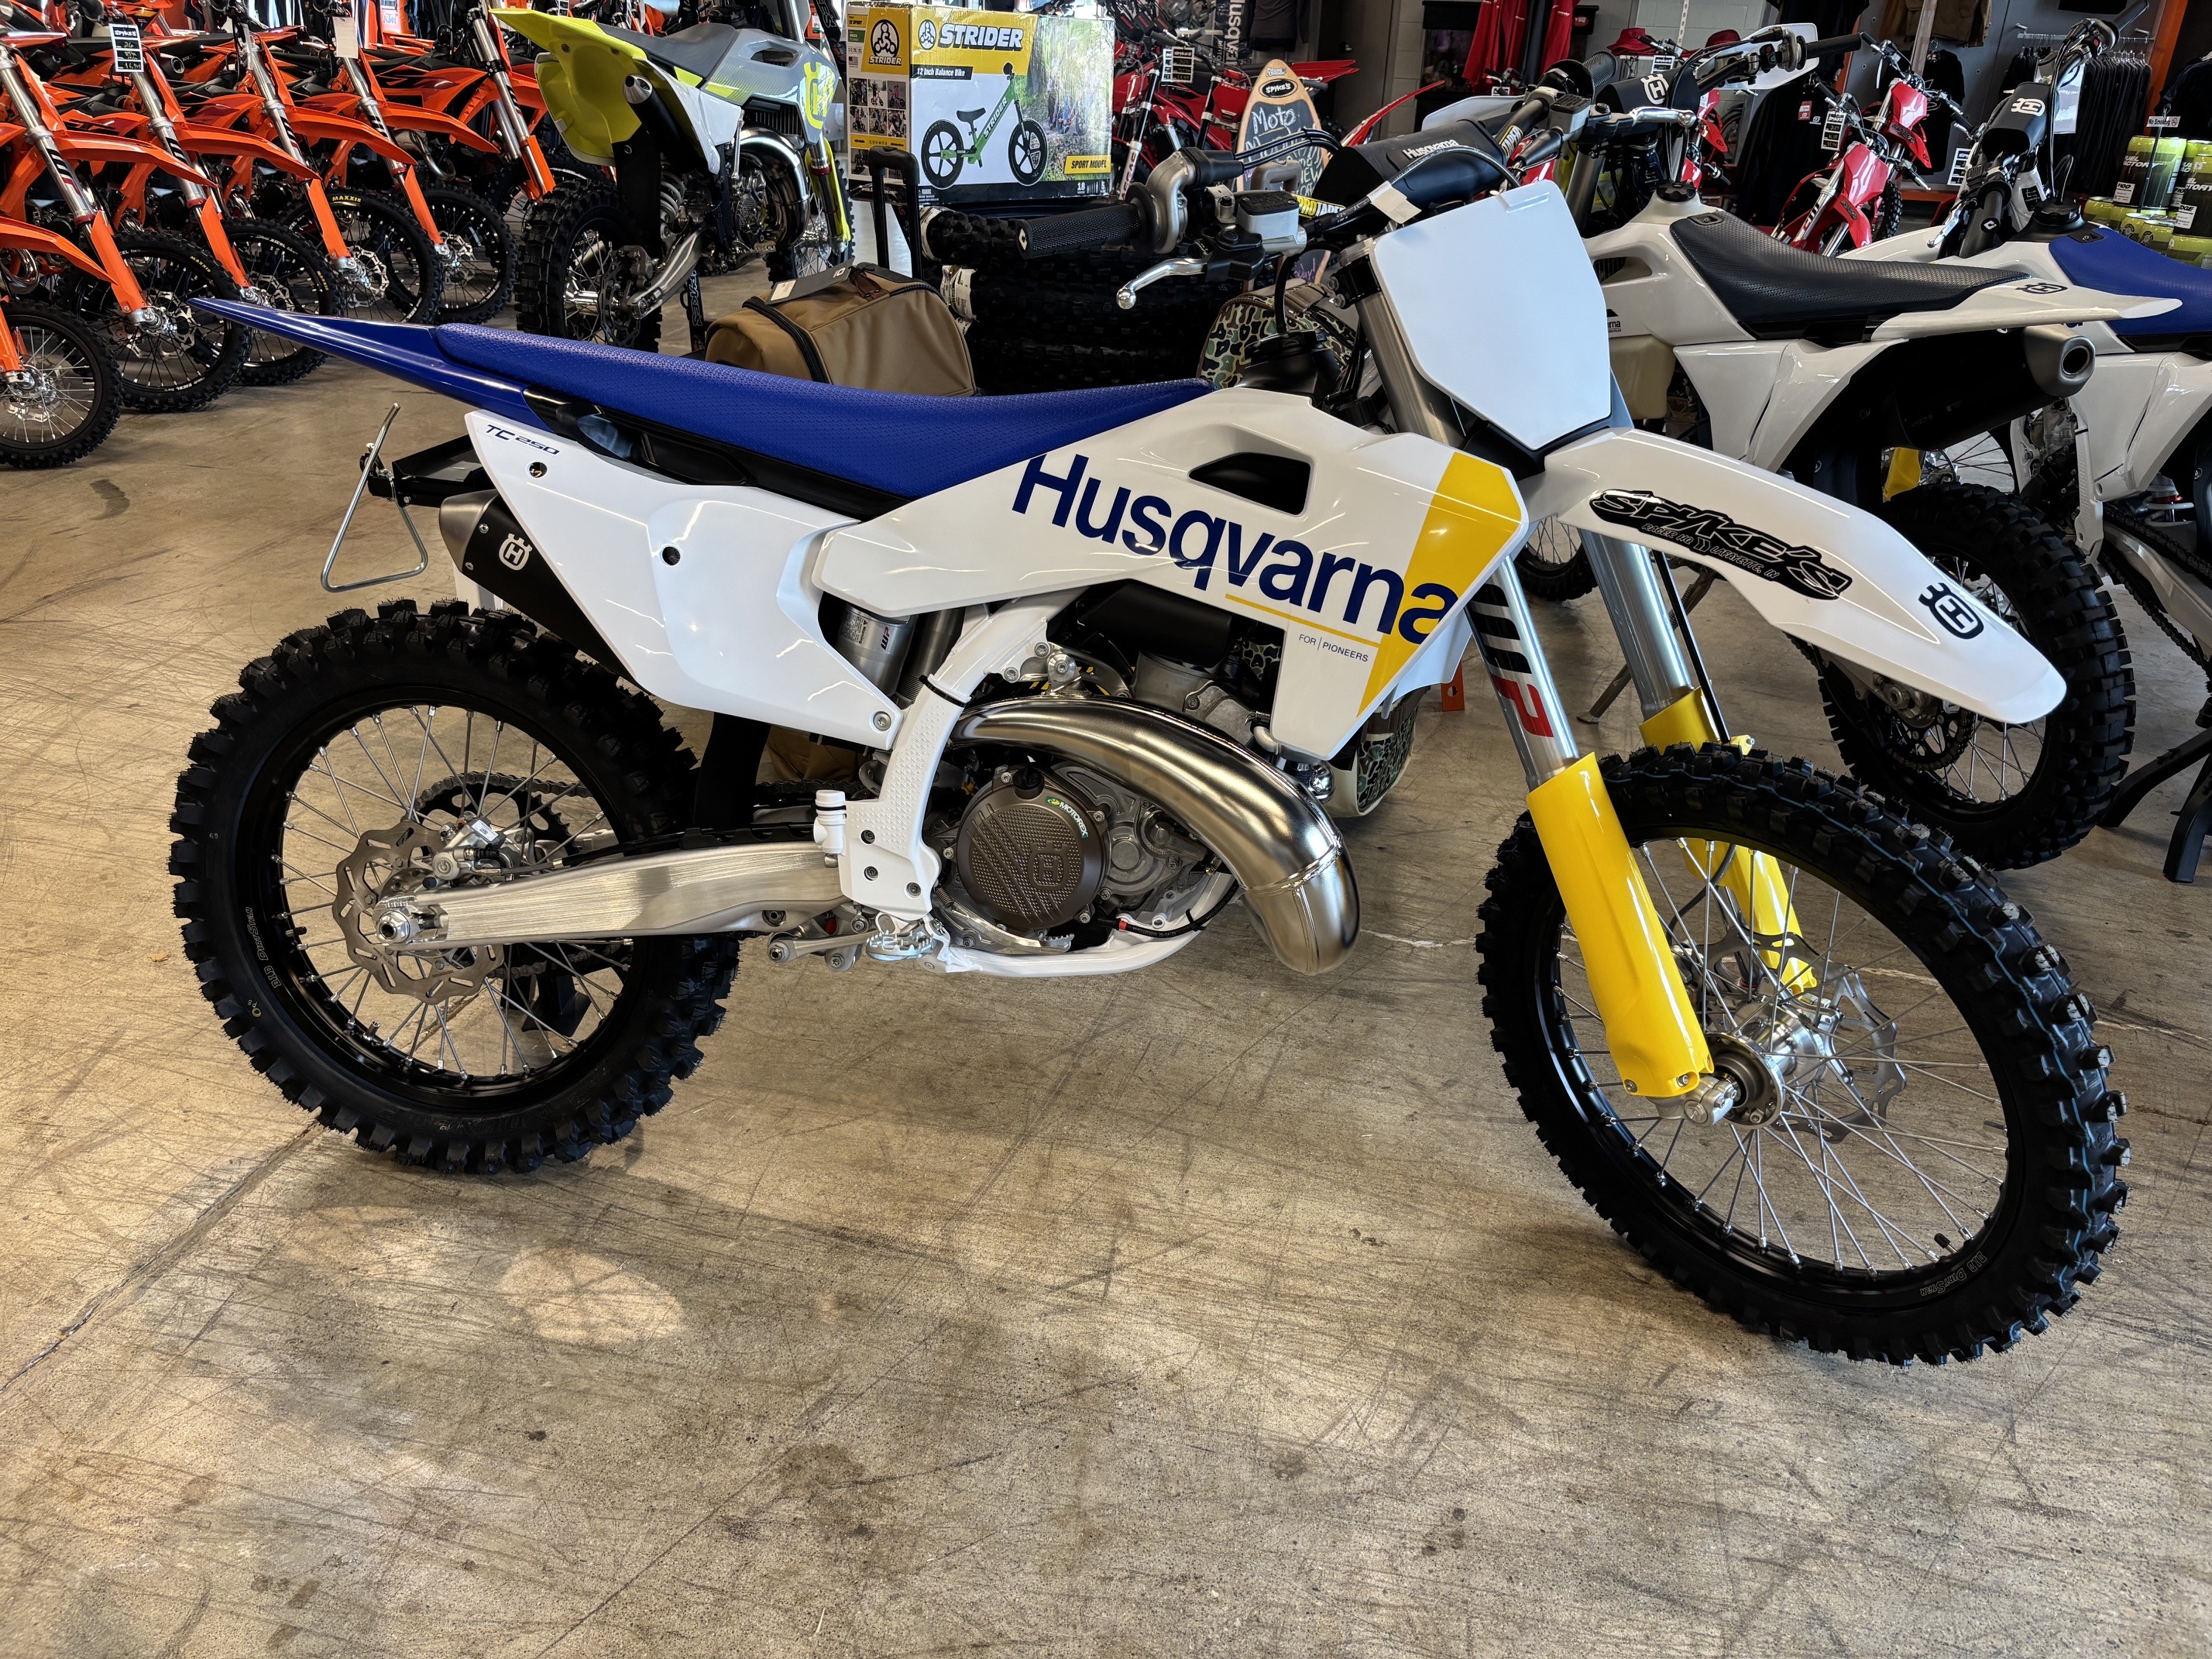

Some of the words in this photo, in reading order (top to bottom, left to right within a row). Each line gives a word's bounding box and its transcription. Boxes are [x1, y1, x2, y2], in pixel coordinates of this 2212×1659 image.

[938, 23, 1024, 51] STRIDER
[869, 56, 902, 66] STRIDER
[935, 68, 954, 77] Balance
[983, 96, 1008, 139] STRIDER
[1252, 106, 1297, 135] Moto
[1402, 139, 1459, 160] Husqvarna
[1071, 160, 1090, 170] SPORT
[1090, 159, 1107, 169] MODEL
[1077, 182, 1085, 191] 18
[190, 256, 211, 273] MAXXIS
[316, 270, 329, 291] MAXXIS
[486, 424, 515, 441] TC
[515, 435, 560, 455] 250
[1592, 490, 1850, 596] SPYKE'S
[1642, 523, 1677, 541] RACER
[1676, 533, 1694, 545] HQ
[1012, 454, 1459, 644] Husqvarna
[1709, 545, 1764, 573] LAFAYETTE,
[1764, 570, 1780, 579] IN
[1298, 634, 1317, 646] FOR
[1322, 641, 1369, 662] PIONEERS
[1059, 801, 1088, 838] MOTOREX
[263, 965, 282, 989] DID
[1966, 1250, 1988, 1273] DID
